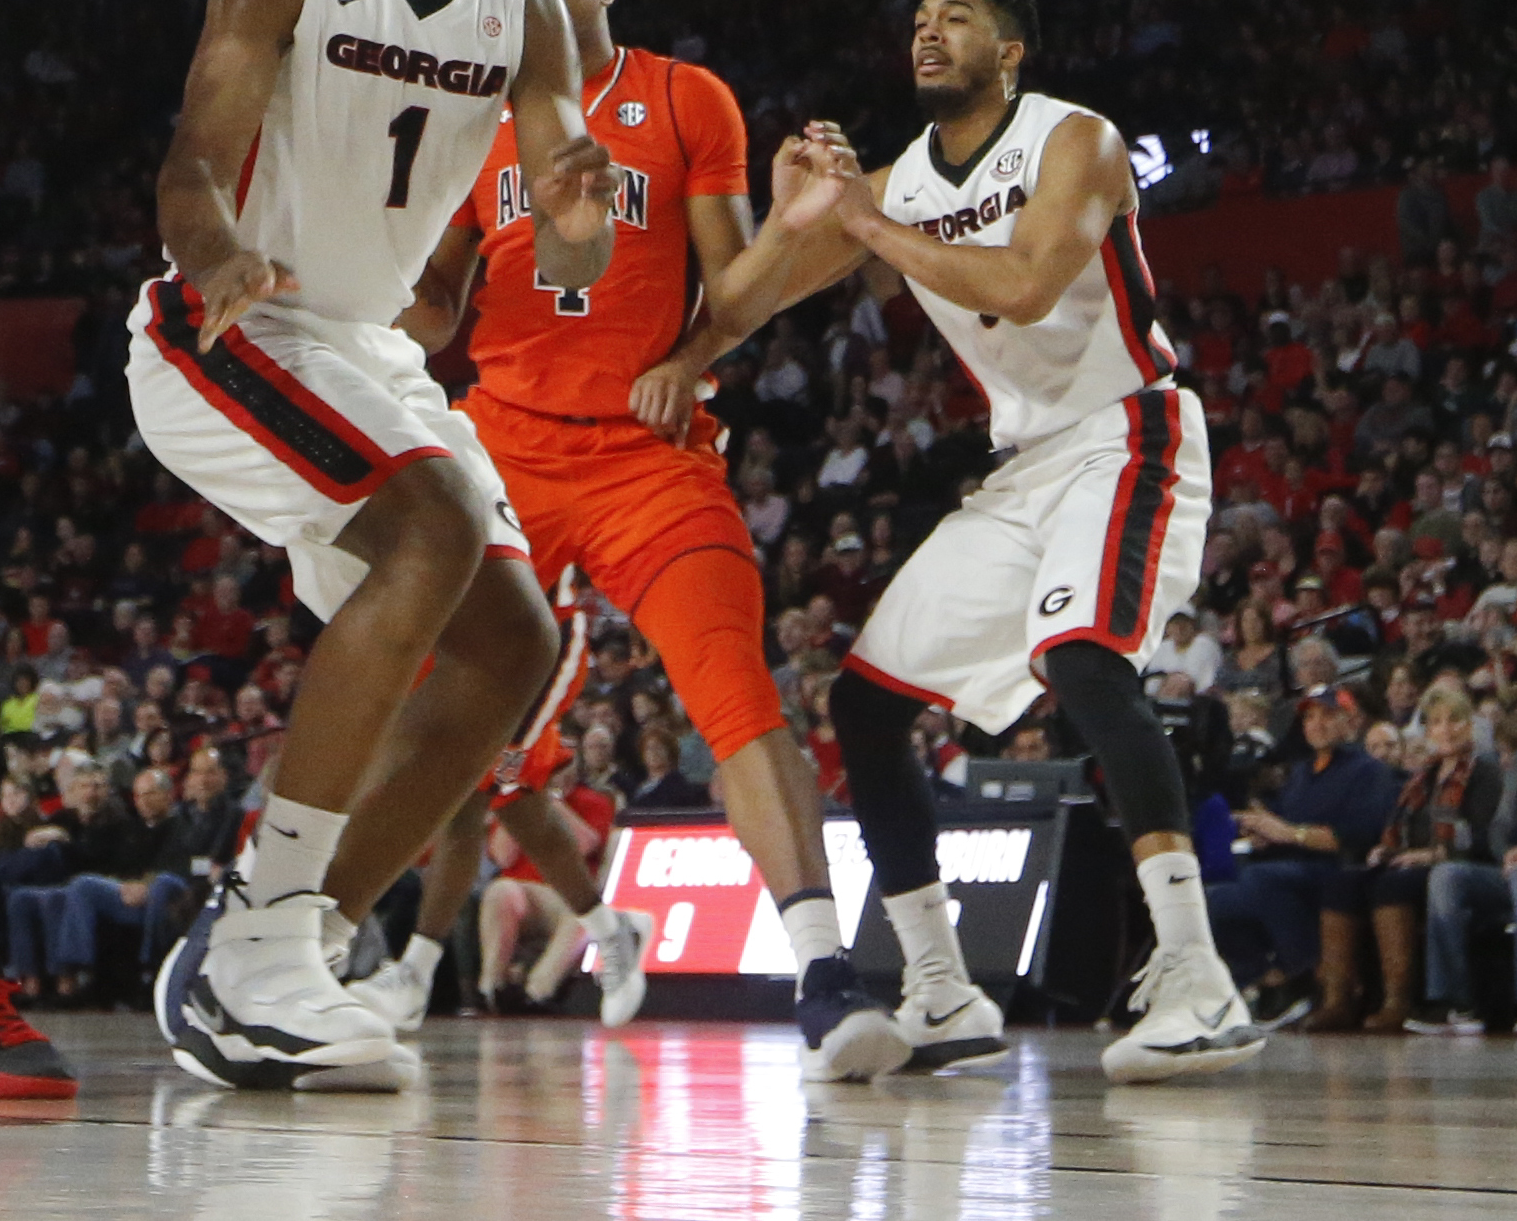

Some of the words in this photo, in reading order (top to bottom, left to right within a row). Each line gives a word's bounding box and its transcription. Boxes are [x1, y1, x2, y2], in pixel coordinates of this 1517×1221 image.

[326, 33, 508, 98] GEORGIA
[385, 106, 430, 210] 1
[998, 150, 1023, 174] SEC
[911, 184, 1028, 246] EORGIA
[936, 829, 1033, 884] BURN
[658, 901, 695, 963] 9
